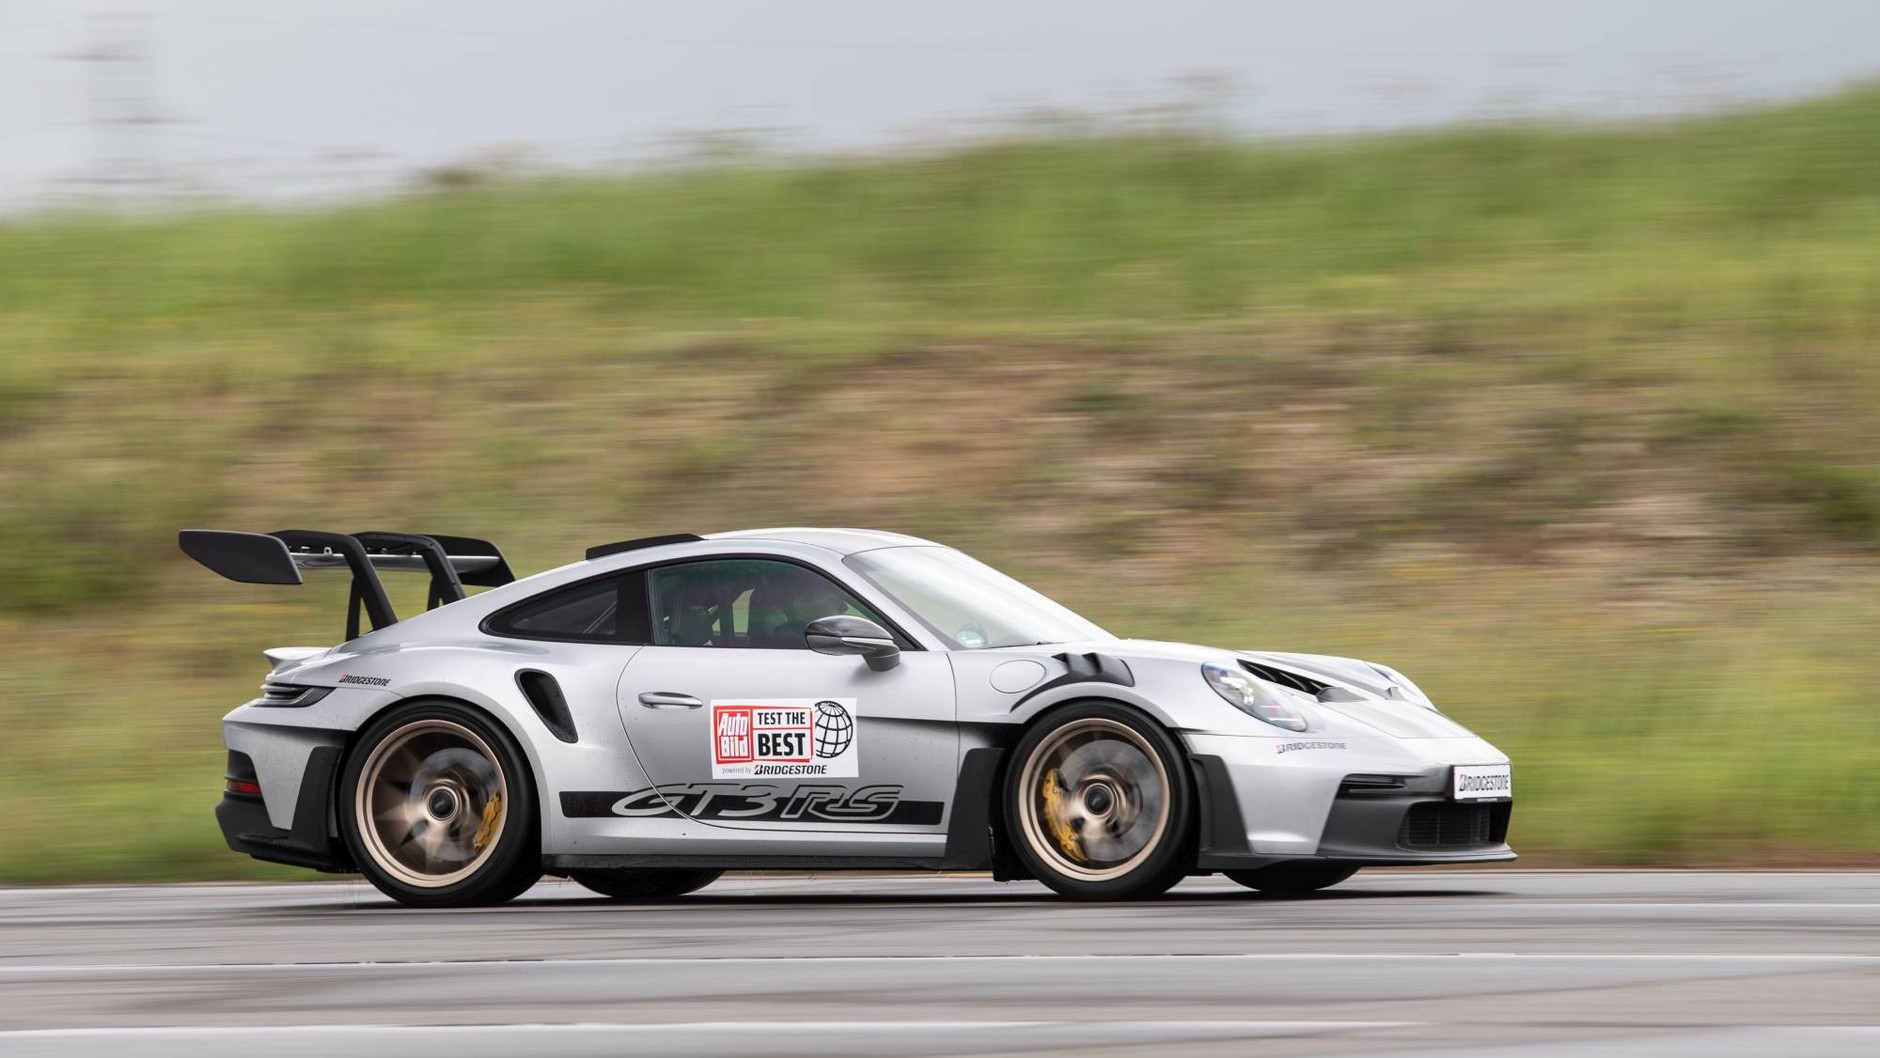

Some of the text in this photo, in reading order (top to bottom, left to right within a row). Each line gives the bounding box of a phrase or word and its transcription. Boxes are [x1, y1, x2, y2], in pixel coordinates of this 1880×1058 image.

[339, 673, 392, 687] BRIDGESTONE
[719, 713, 748, 736] Auto
[757, 712, 806, 725] TEST THE
[721, 736, 748, 756] Bild
[757, 733, 806, 756] BEST
[1275, 742, 1347, 754] BRIDGESTONE
[722, 764, 828, 775] powered by BRIDGESTONE
[1458, 774, 1509, 791] BRIDGESTONE
